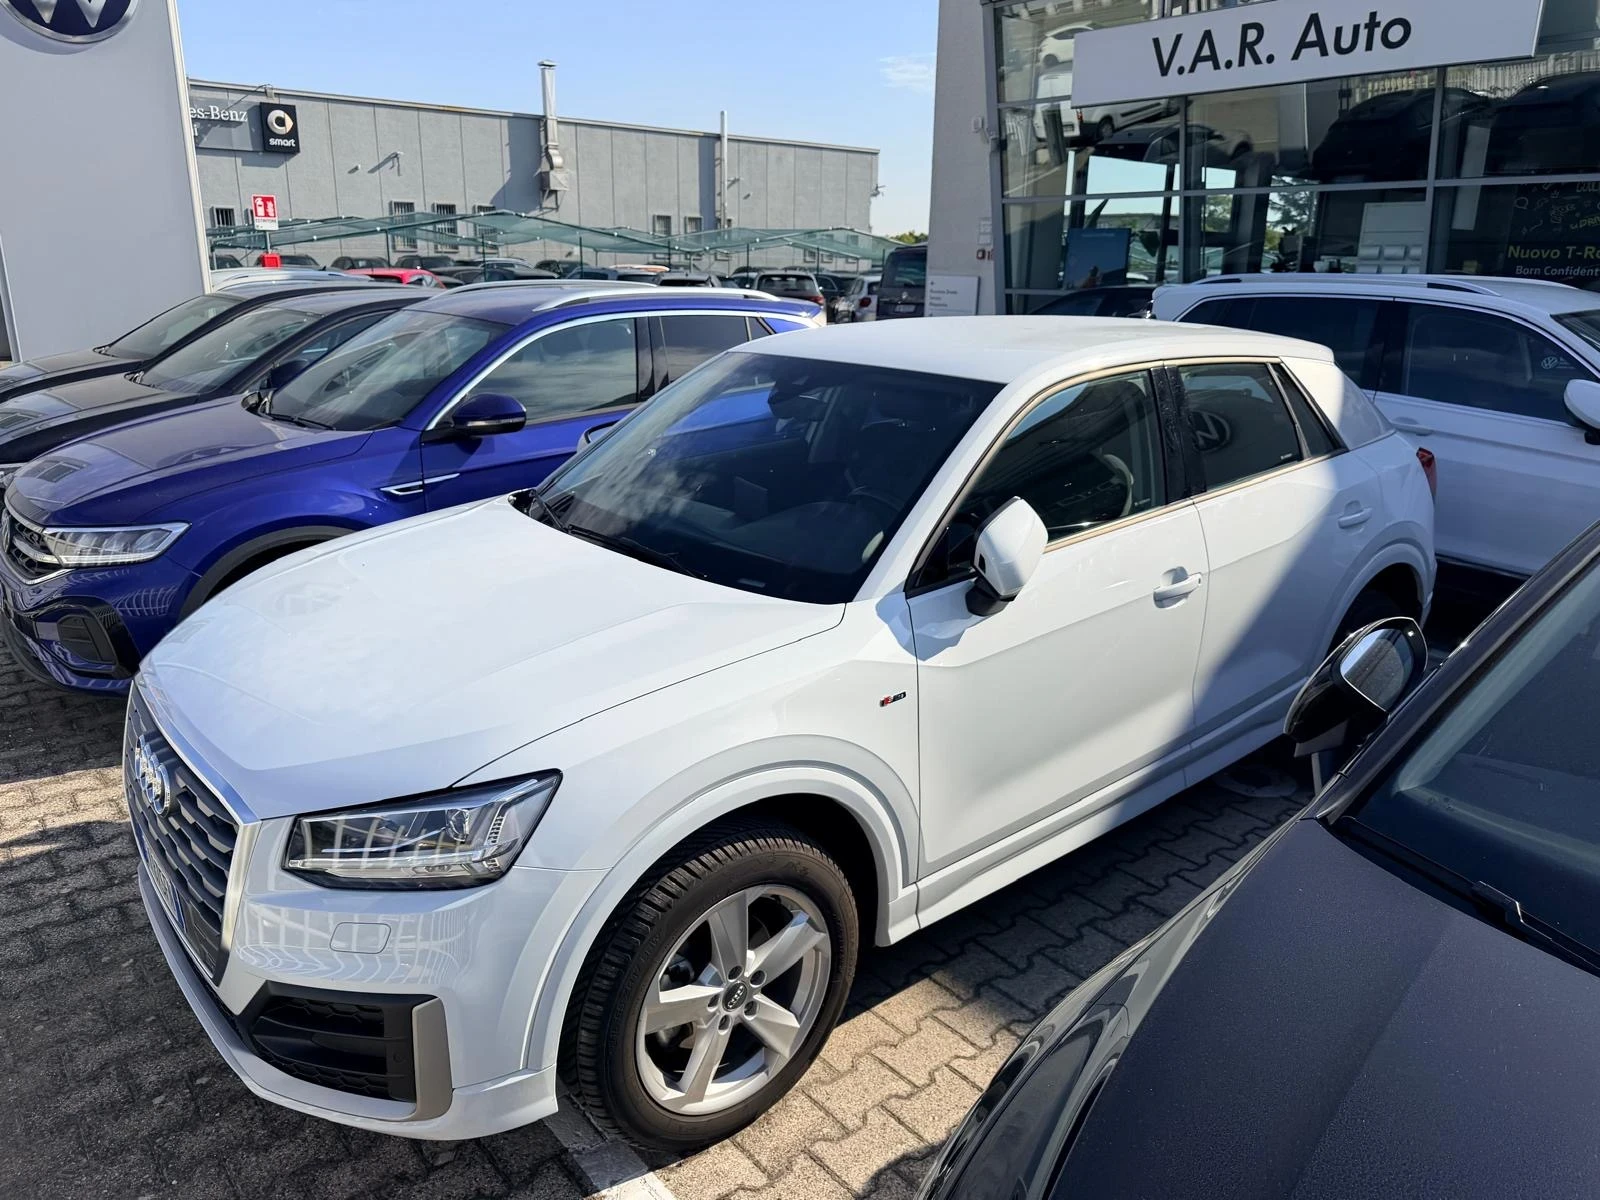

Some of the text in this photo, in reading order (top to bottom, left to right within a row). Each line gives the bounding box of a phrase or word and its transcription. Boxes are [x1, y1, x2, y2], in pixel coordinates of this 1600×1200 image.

[1152, 11, 1411, 77] V.A.R. Auto
[269, 138, 296, 147] smart
[1507, 245, 1560, 259] Nuovo
[1515, 265, 1600, 276] Born Confident
